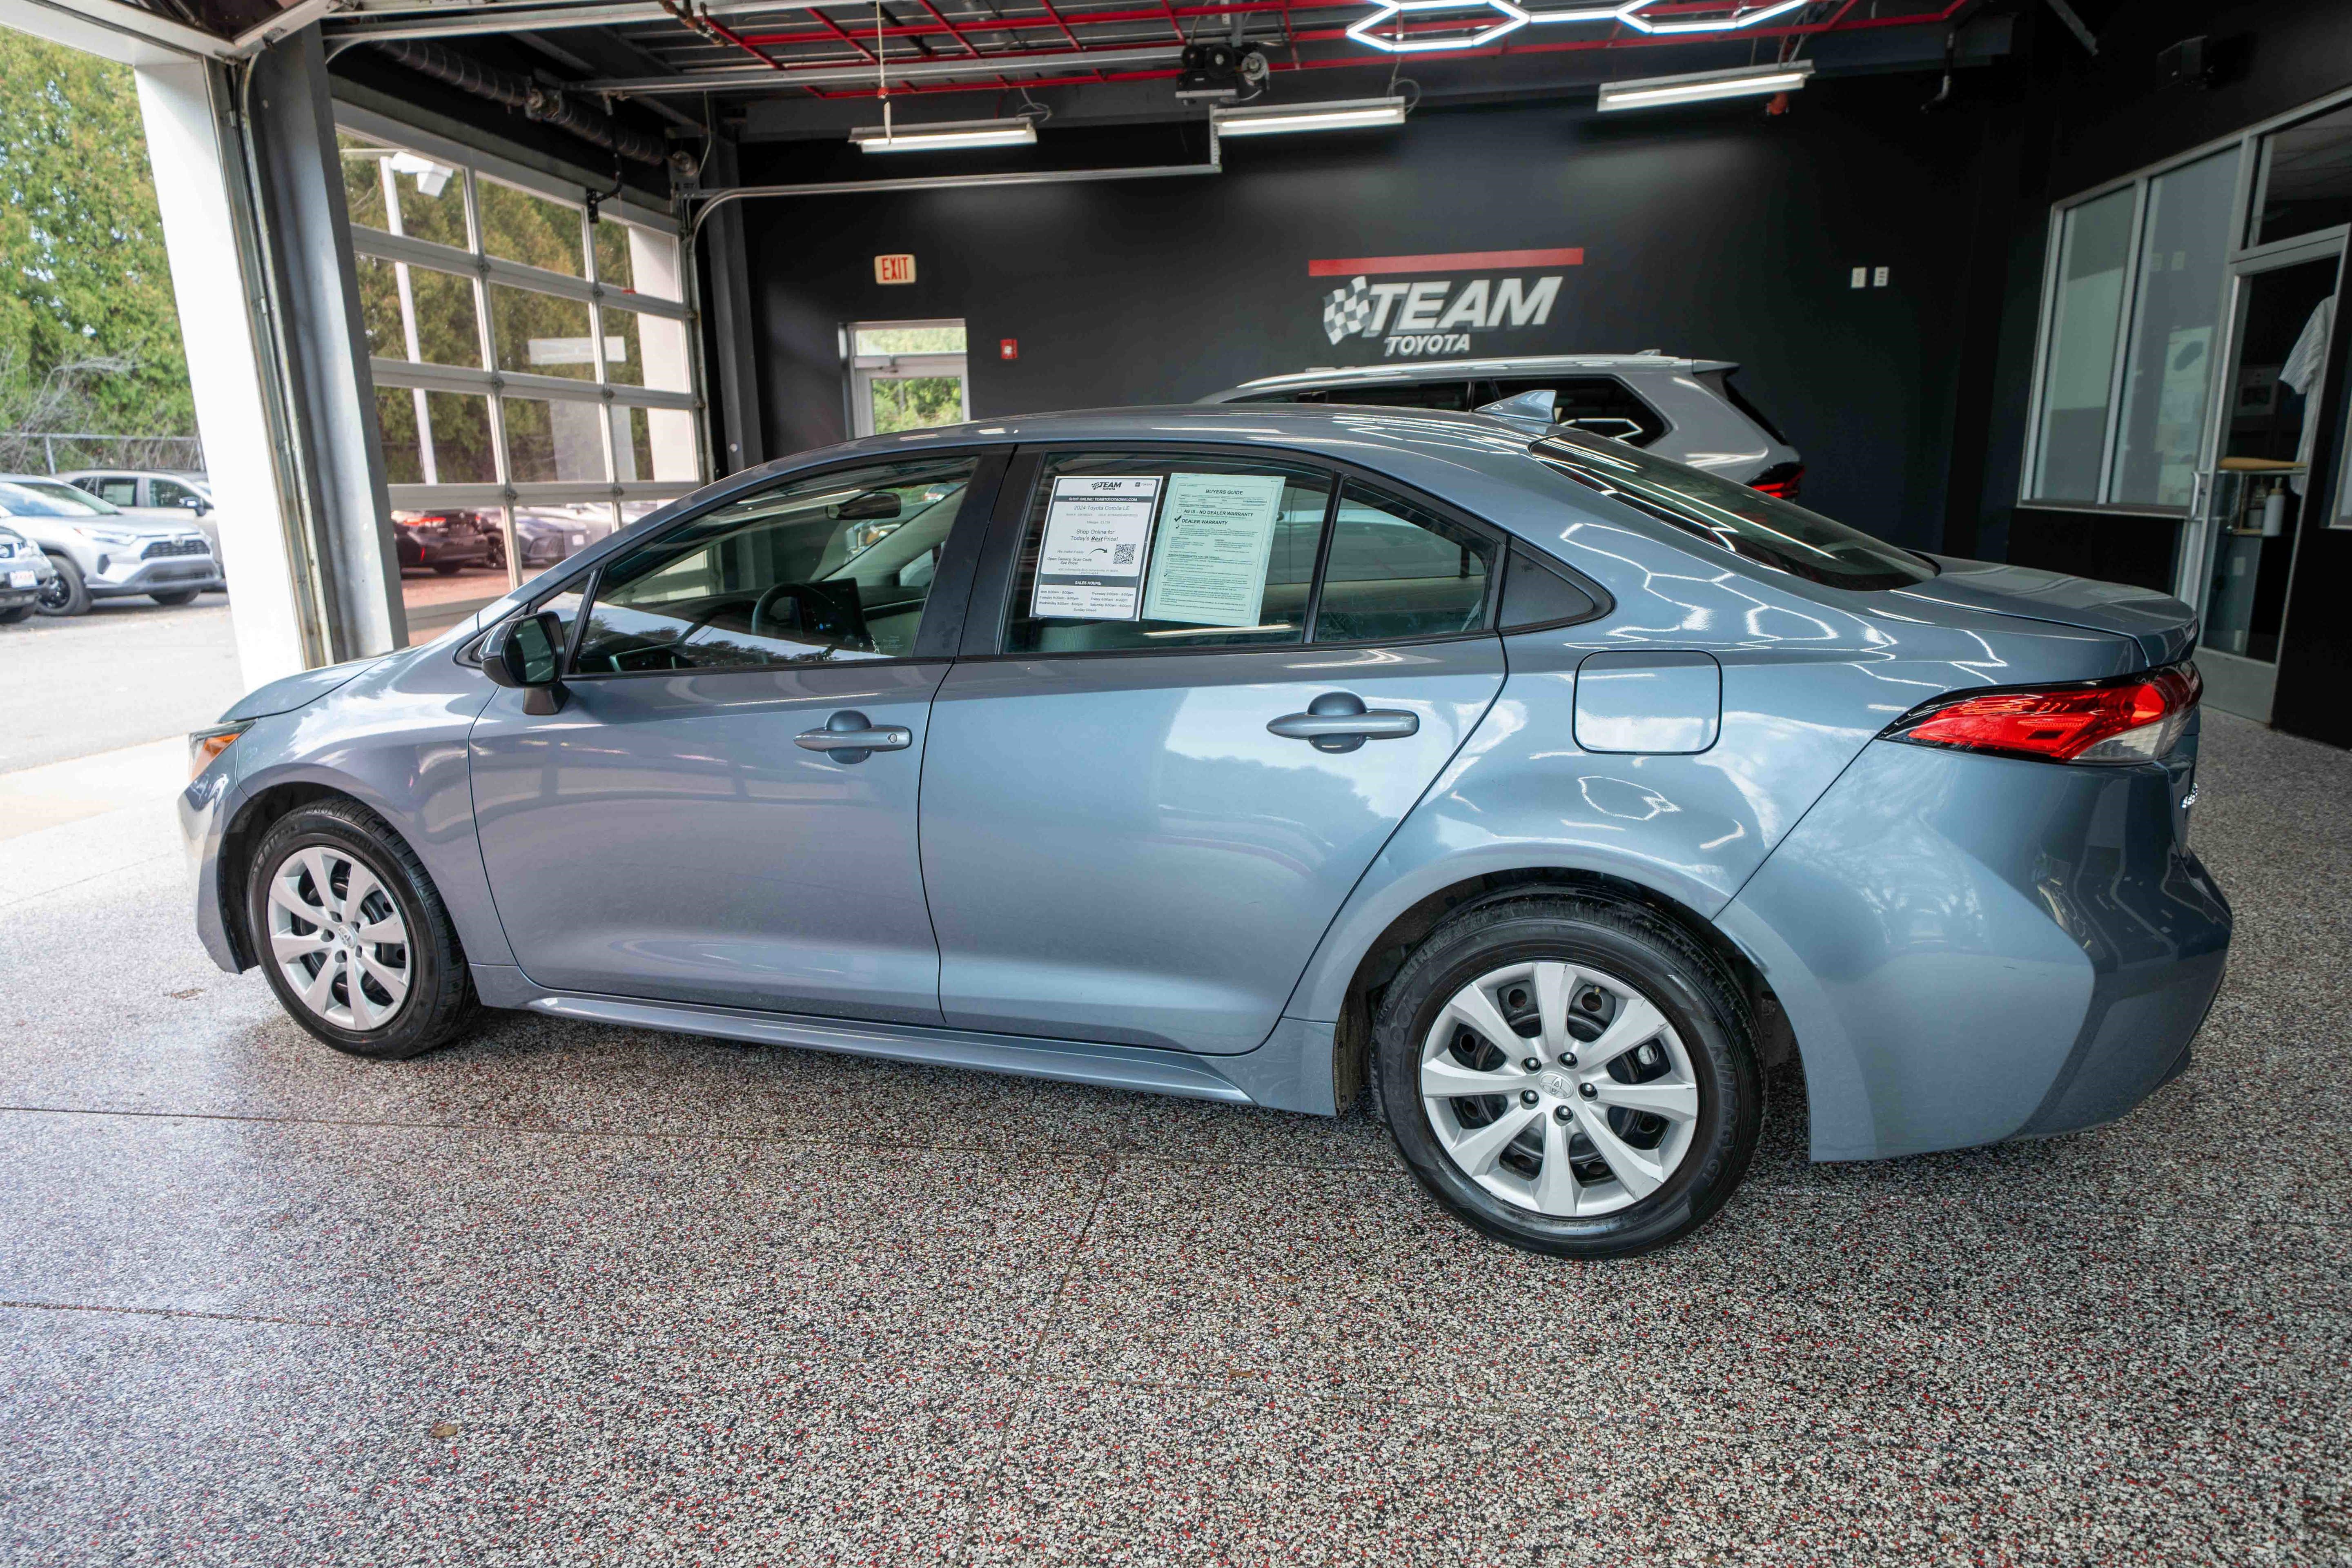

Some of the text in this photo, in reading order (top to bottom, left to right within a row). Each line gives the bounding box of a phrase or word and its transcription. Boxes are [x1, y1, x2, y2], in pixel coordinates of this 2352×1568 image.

[881, 257, 909, 281] EXIT
[1363, 276, 1564, 336] TEAM
[1385, 334, 1470, 357] TOYOTA
